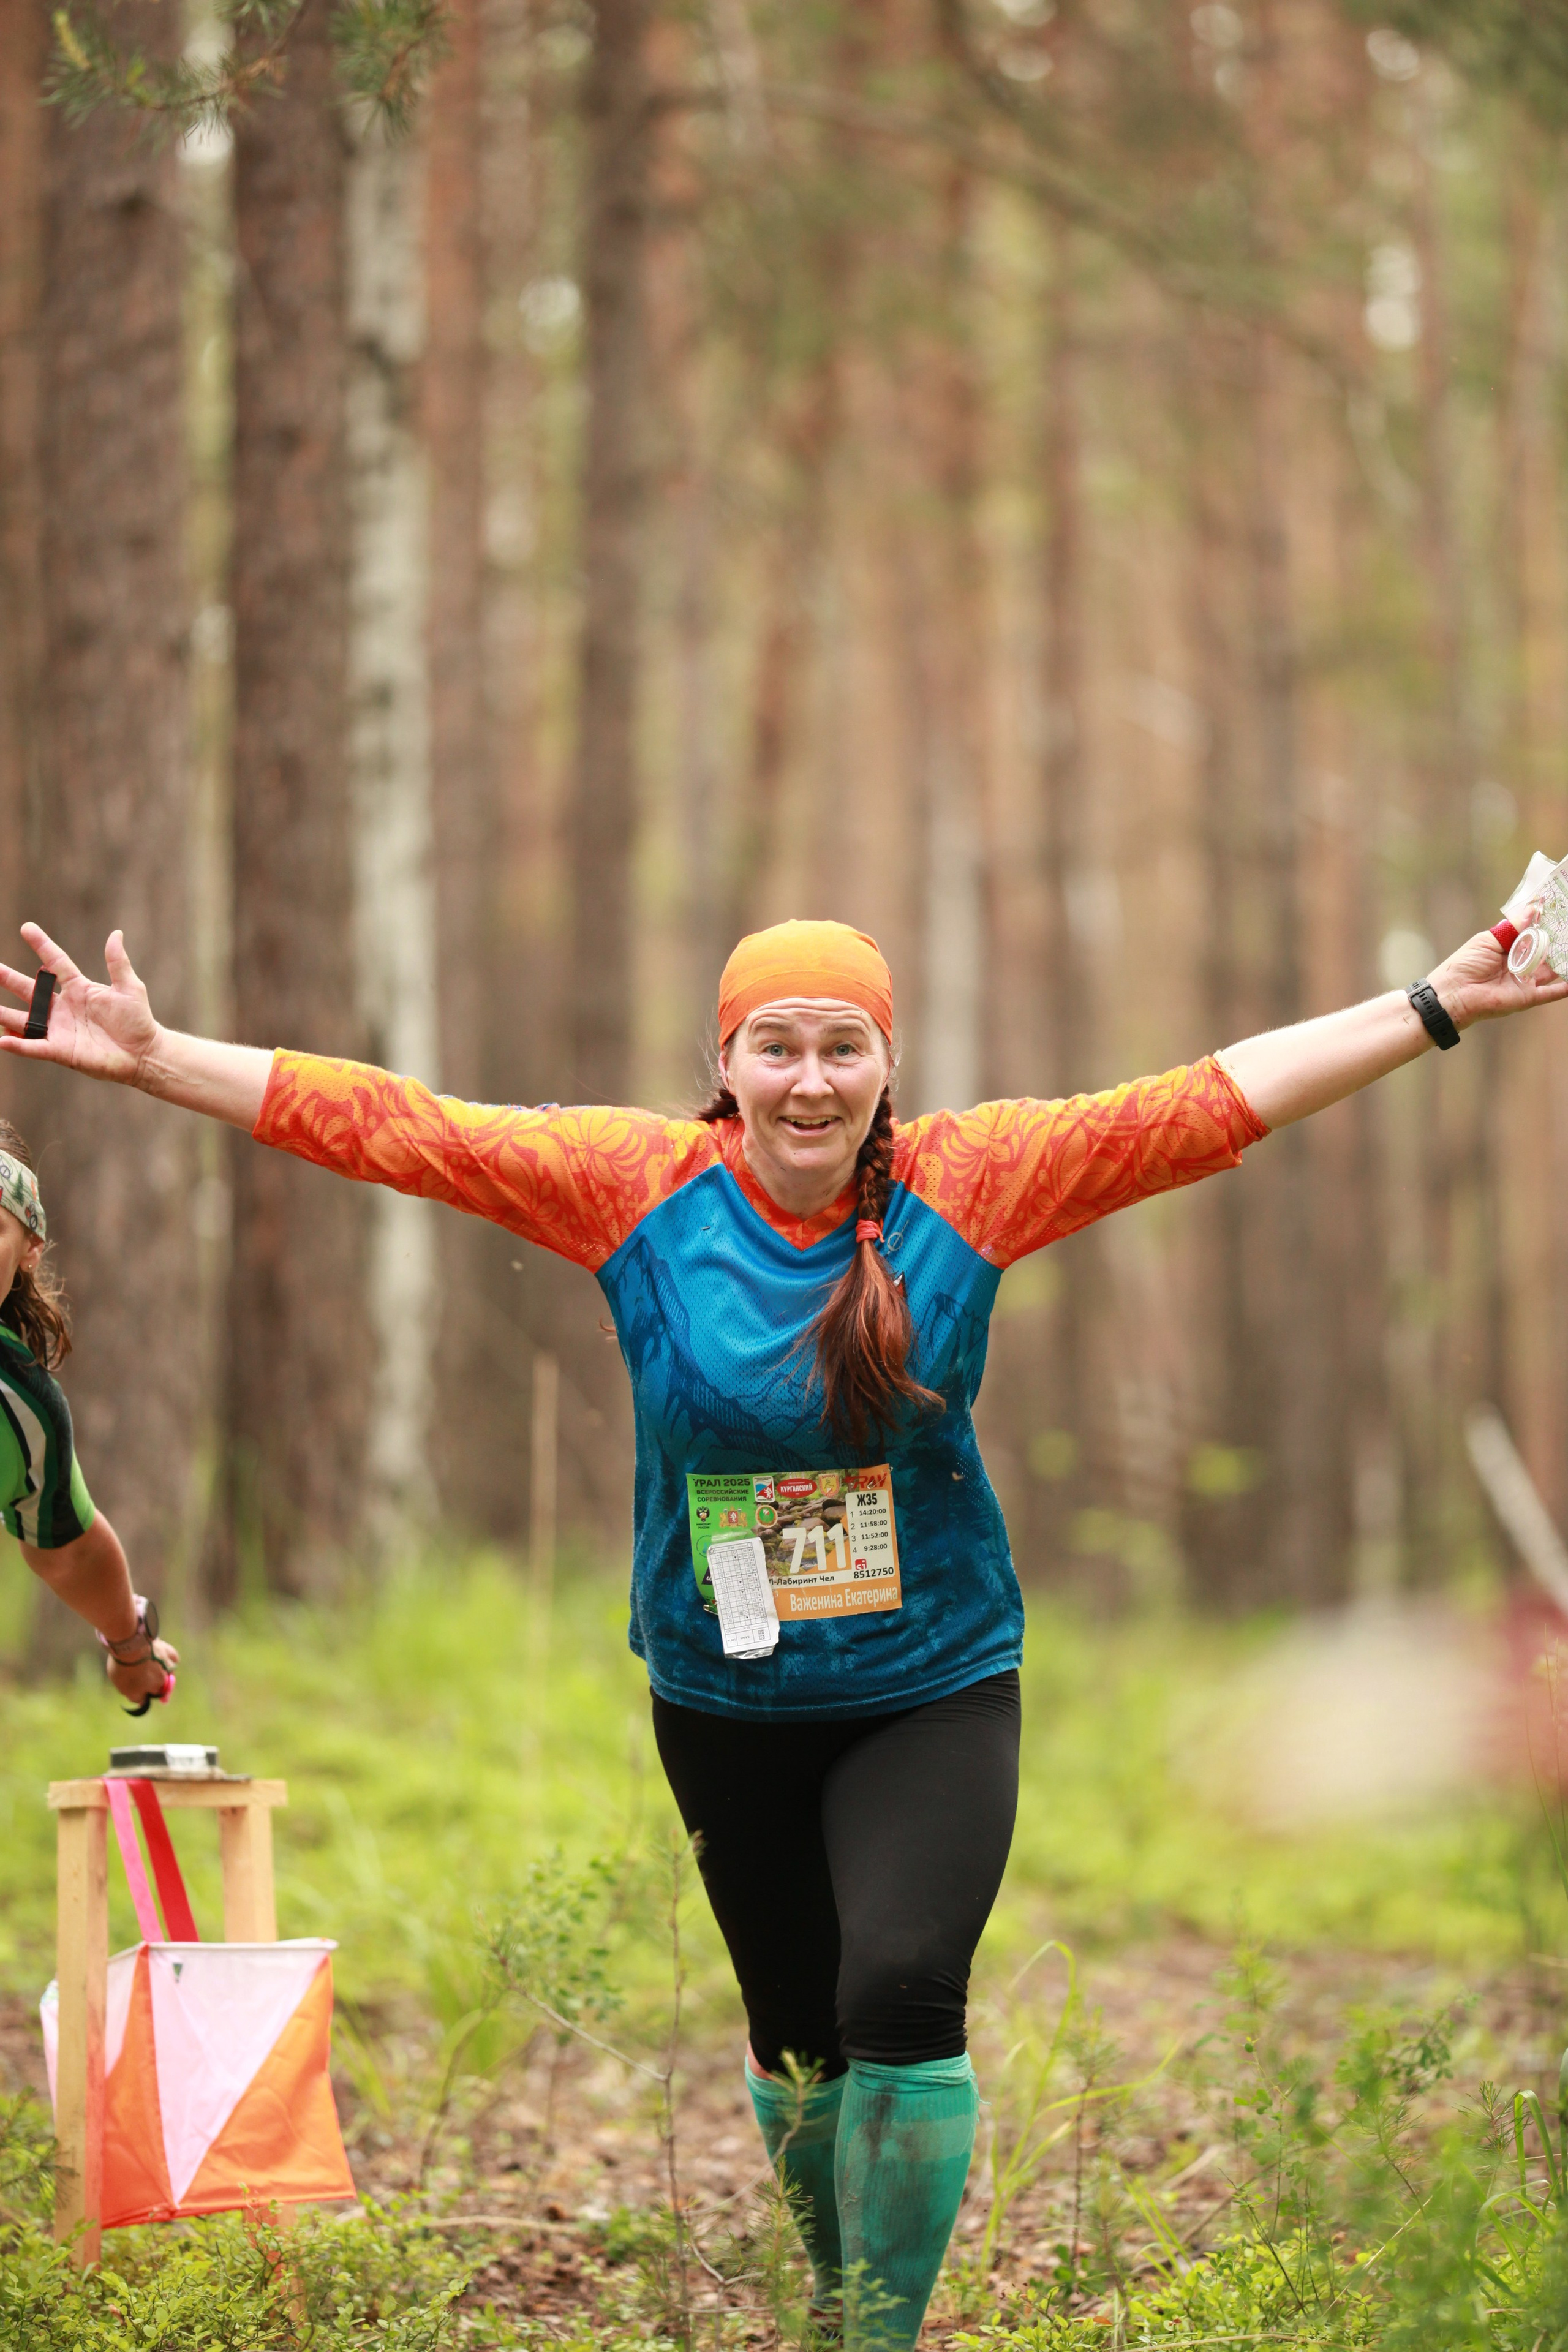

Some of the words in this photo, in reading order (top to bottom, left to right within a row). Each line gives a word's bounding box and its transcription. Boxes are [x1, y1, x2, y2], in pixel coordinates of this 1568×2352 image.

[780, 1483, 813, 1493] КУРГАНСКИЙ
[857, 1493, 877, 1506] Ж35
[782, 1523, 846, 1574] 711
[853, 1567, 894, 1579] 8512750
[790, 1593, 843, 1611] Важенина
[845, 1586, 897, 1607] Екатерина
